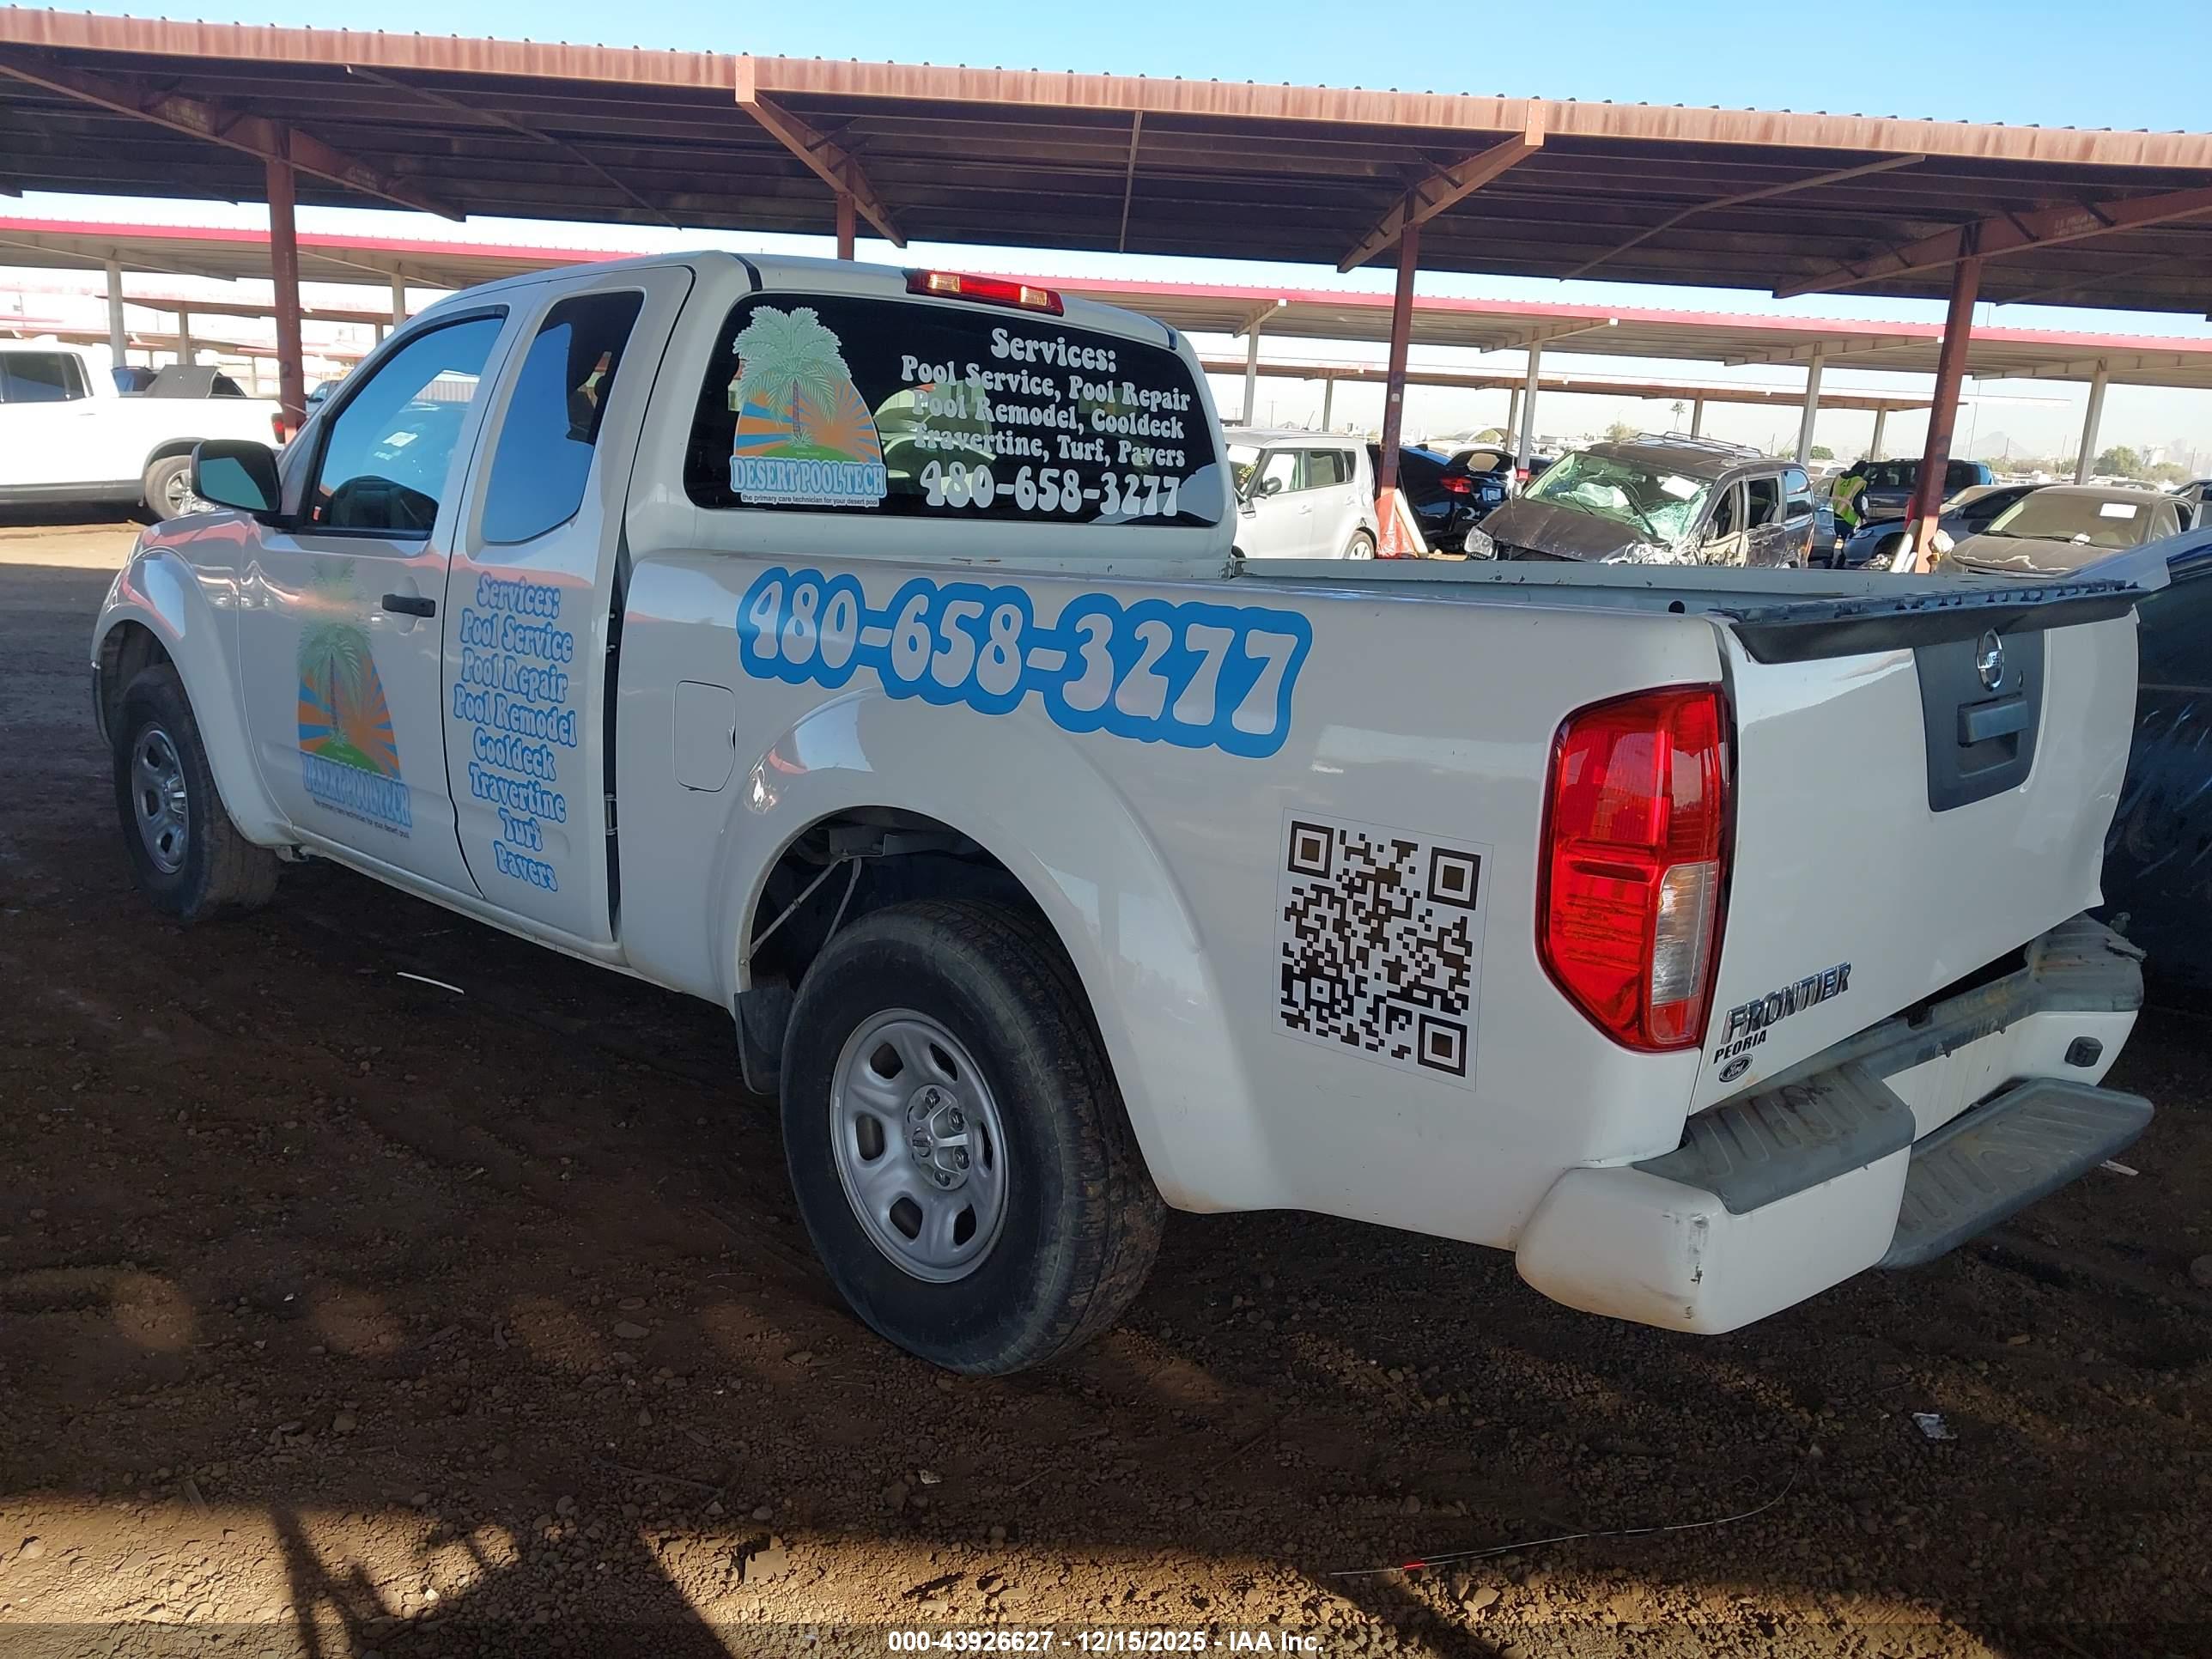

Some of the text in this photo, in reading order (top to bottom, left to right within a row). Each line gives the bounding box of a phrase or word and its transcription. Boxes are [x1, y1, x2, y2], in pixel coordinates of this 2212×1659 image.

[991, 327, 1116, 373] Services:
[902, 355, 1191, 412] Pool Service, Pool Repair
[912, 389, 1185, 439] Pool Remodel, Cooldeck
[913, 422, 1186, 467] Travertine, Turf, Pavers
[732, 459, 884, 495] DESERT POOL TECH
[754, 495, 777, 504] primary
[847, 497, 865, 506] desert
[866, 499, 878, 507] pool
[920, 459, 1181, 517] 480-658-3277
[477, 571, 561, 619] Services:
[460, 608, 574, 663] Pool Service
[744, 574, 1305, 745] 480-658-3277
[461, 647, 568, 703] Pool Repair
[453, 683, 577, 748] Pool Remodel
[473, 726, 556, 781] Cooldeck
[468, 762, 567, 823] Travertine
[498, 807, 543, 852] Turf
[494, 840, 558, 892] Pavers
[1720, 961, 1852, 1045] FRONTIER
[1713, 1030, 1767, 1065] PEORIA
